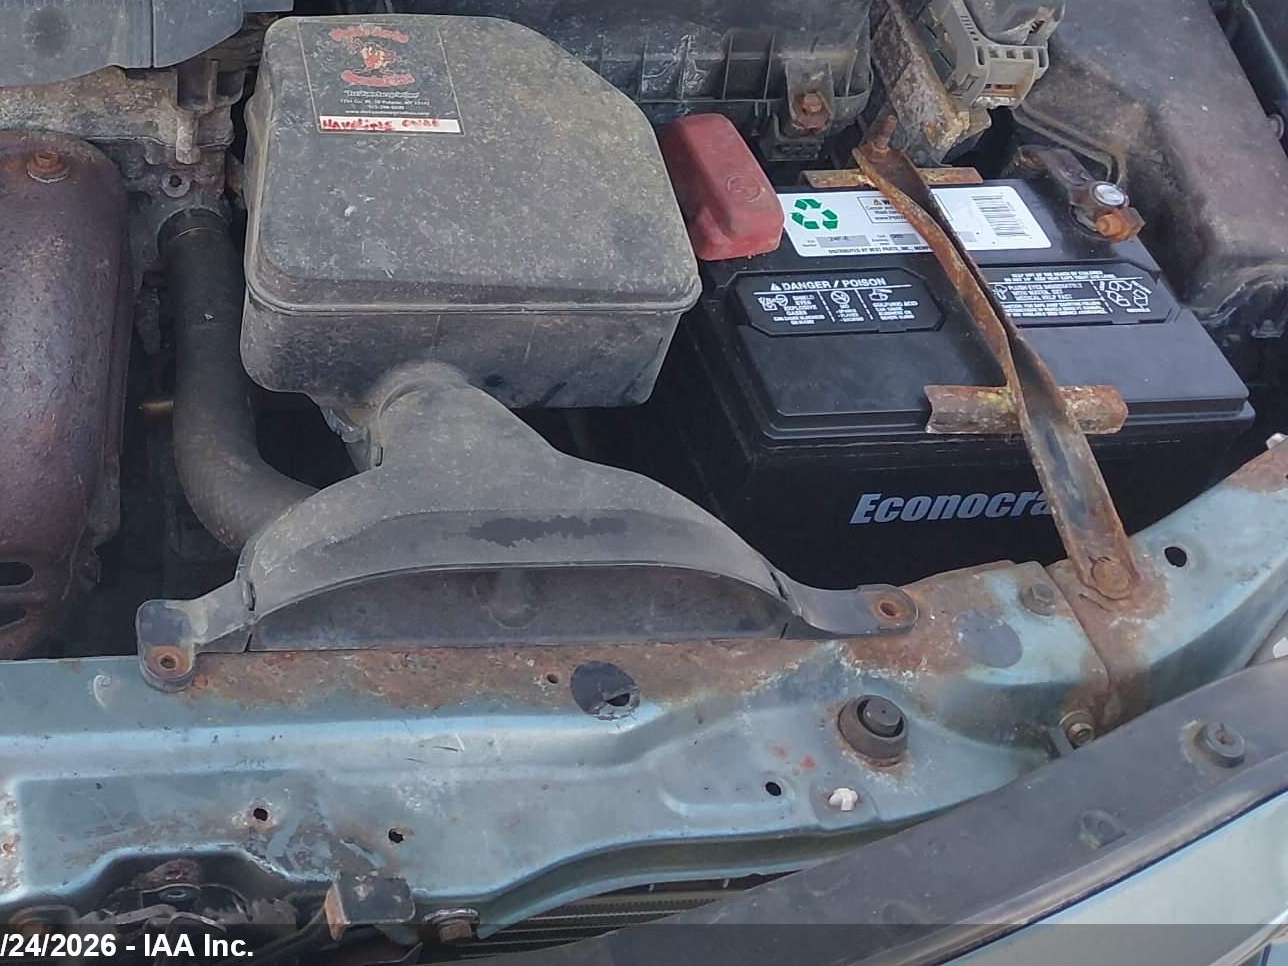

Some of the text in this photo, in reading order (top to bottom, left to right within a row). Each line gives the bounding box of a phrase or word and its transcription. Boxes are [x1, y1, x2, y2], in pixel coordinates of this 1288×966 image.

[781, 280, 832, 291] DANGER
[841, 277, 886, 288] POISON
[849, 490, 1053, 524] Econocra
